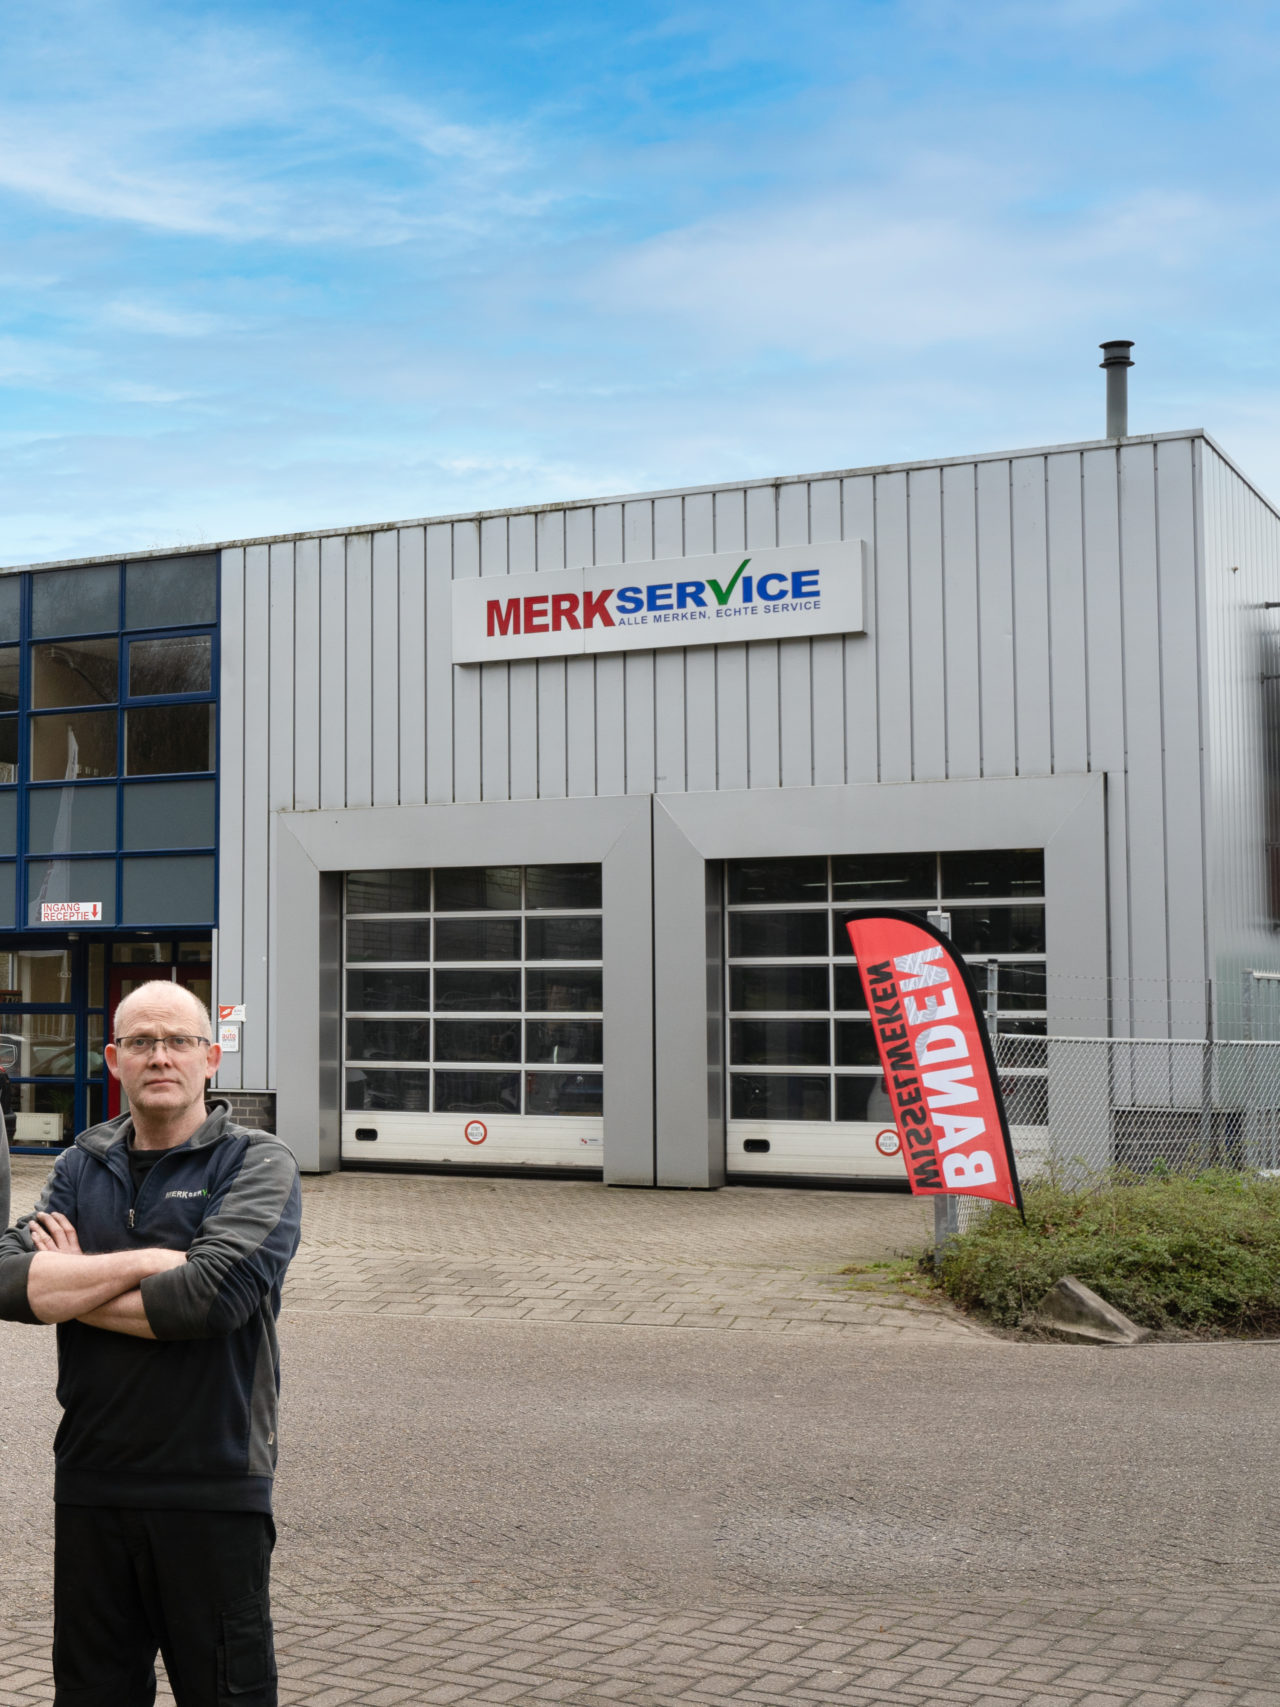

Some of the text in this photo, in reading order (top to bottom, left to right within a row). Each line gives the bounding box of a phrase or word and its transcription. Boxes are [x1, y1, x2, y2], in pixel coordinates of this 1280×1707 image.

[486, 558, 820, 637] MERKSERVICE
[618, 600, 821, 626] ALLE MERKEN, ECHTE SERVICE
[43, 903, 81, 912] INGANG
[43, 912, 90, 921] RECEPTIE
